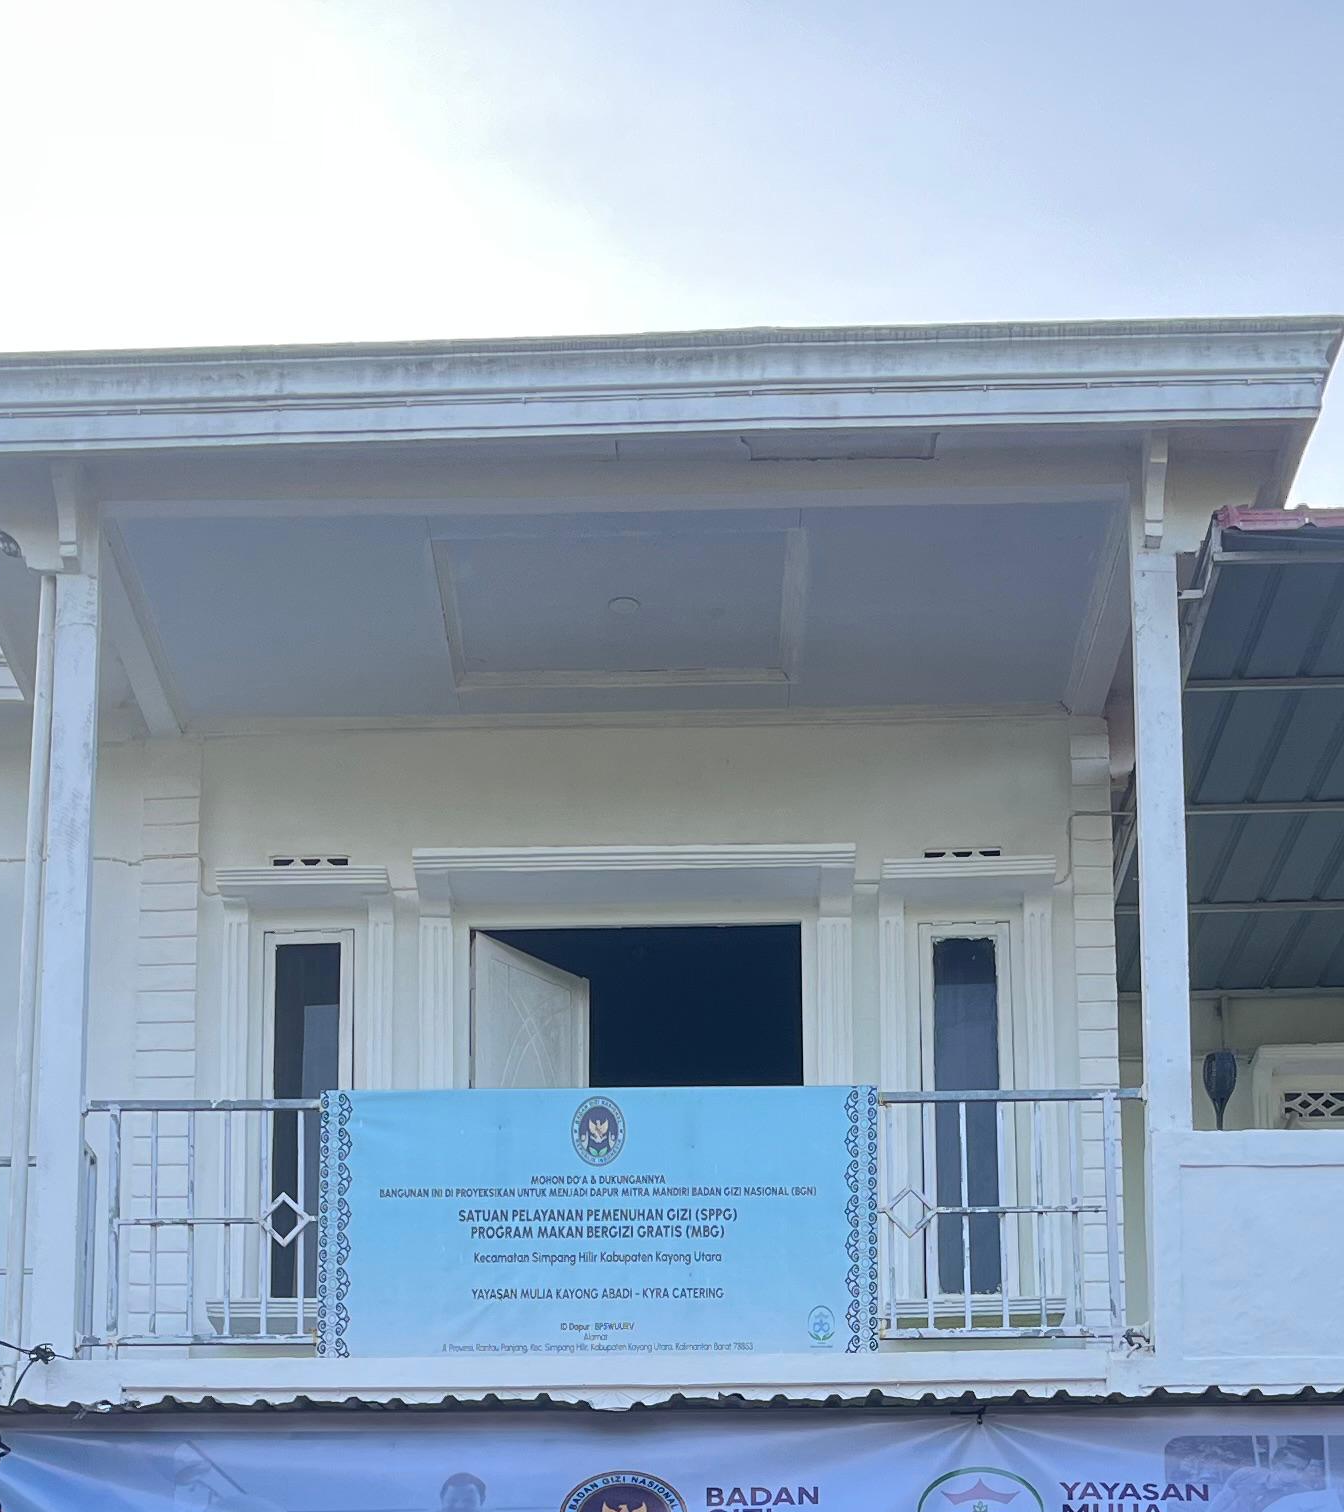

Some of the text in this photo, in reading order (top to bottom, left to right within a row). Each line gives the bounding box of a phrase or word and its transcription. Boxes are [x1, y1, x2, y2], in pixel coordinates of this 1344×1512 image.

[531, 1175, 565, 1185] MOHON
[591, 1175, 597, 1185] &
[599, 1174, 666, 1185] DUKUNGANNYA
[379, 1186, 817, 1198] BANGUNAN INI DI PROYEKSIKAN UNTUK MENJADI DAPUR MITRA MANDIRI BADAN GIZI NASIONAL (BGN)
[458, 1207, 738, 1222] SATUAN PELAYANAN PEMENUHAN GIZI (SPPG)
[470, 1226, 533, 1239] PROGRAM
[537, 1225, 583, 1239] MAKAN
[586, 1225, 634, 1239] BERGIZI
[637, 1225, 683, 1238] GRATIS
[473, 1251, 722, 1266] Kecamatan Simpang Hilir Kabupaten Kayong Utara
[471, 1288, 518, 1300] YAYASAN
[520, 1288, 553, 1300] MULIA
[556, 1288, 599, 1300] KAYONG
[601, 1288, 633, 1299] ABADI
[642, 1287, 670, 1299] KYRA
[672, 1287, 724, 1299] CATERING
[568, 1475, 680, 1511] BADAN GIZI NASIONAL
[706, 1486, 820, 1506] BADAN
[1059, 1482, 1209, 1501] YAYASAN
